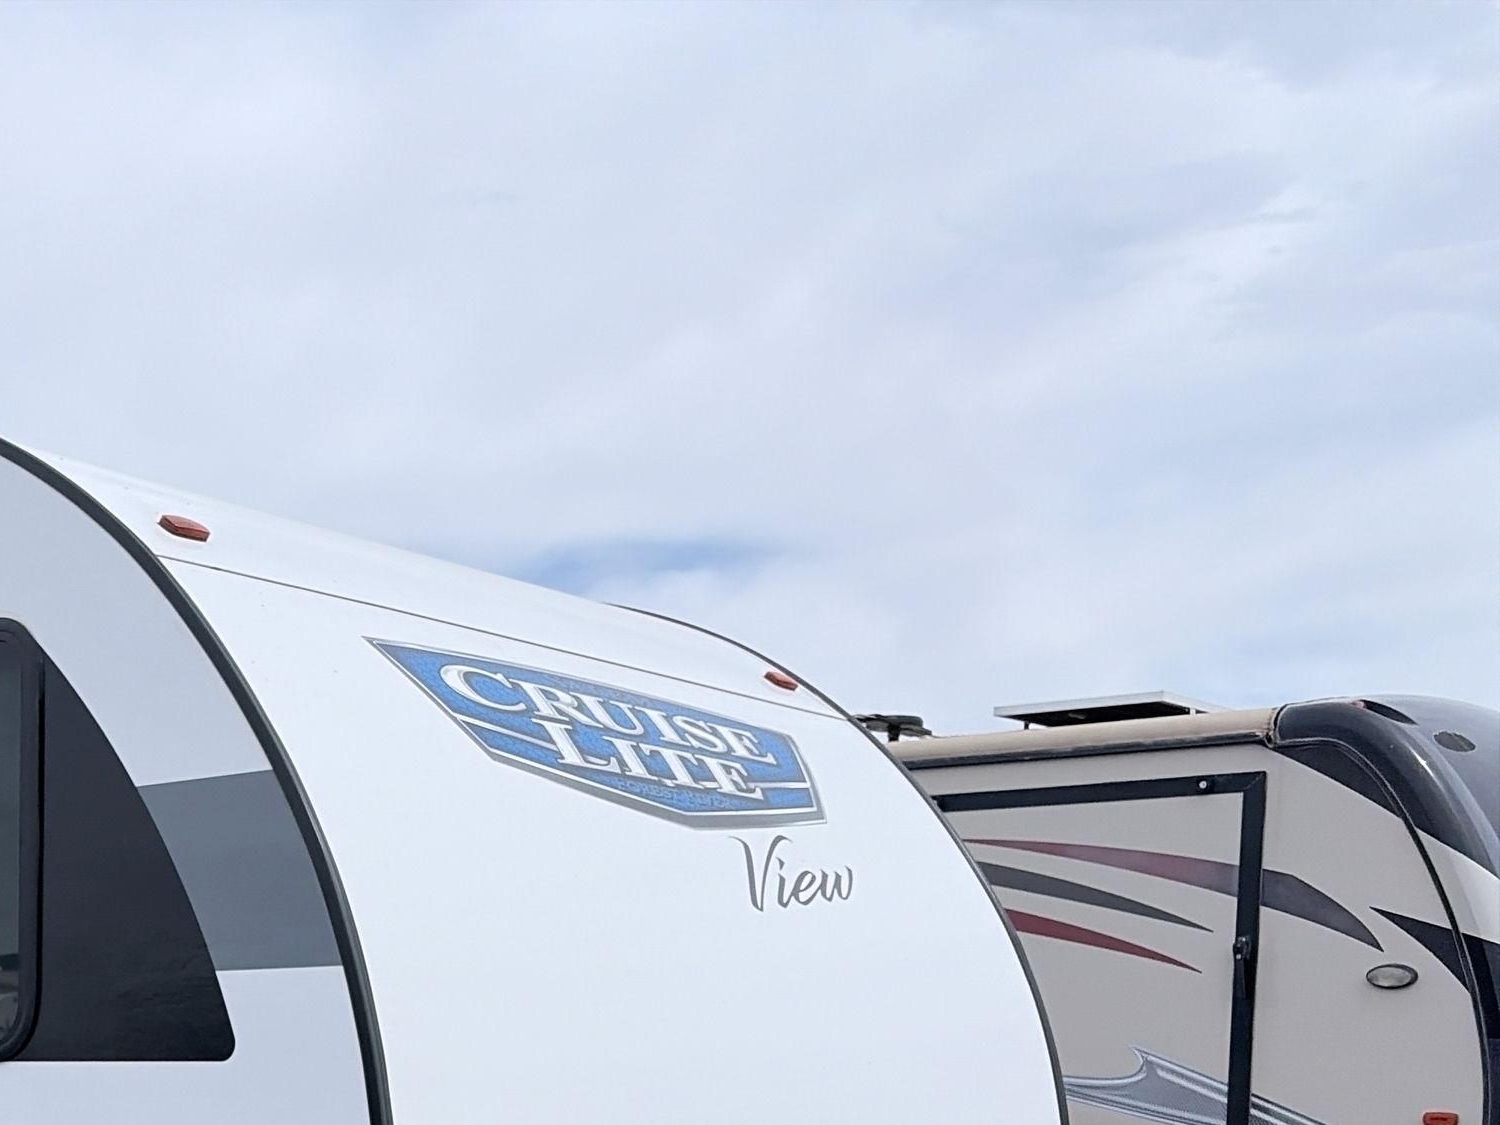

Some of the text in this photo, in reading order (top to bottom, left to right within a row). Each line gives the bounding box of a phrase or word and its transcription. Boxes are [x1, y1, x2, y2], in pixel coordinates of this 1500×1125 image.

[438, 664, 777, 765] CRUISE
[532, 717, 765, 801] LITE
[729, 834, 854, 912] View
